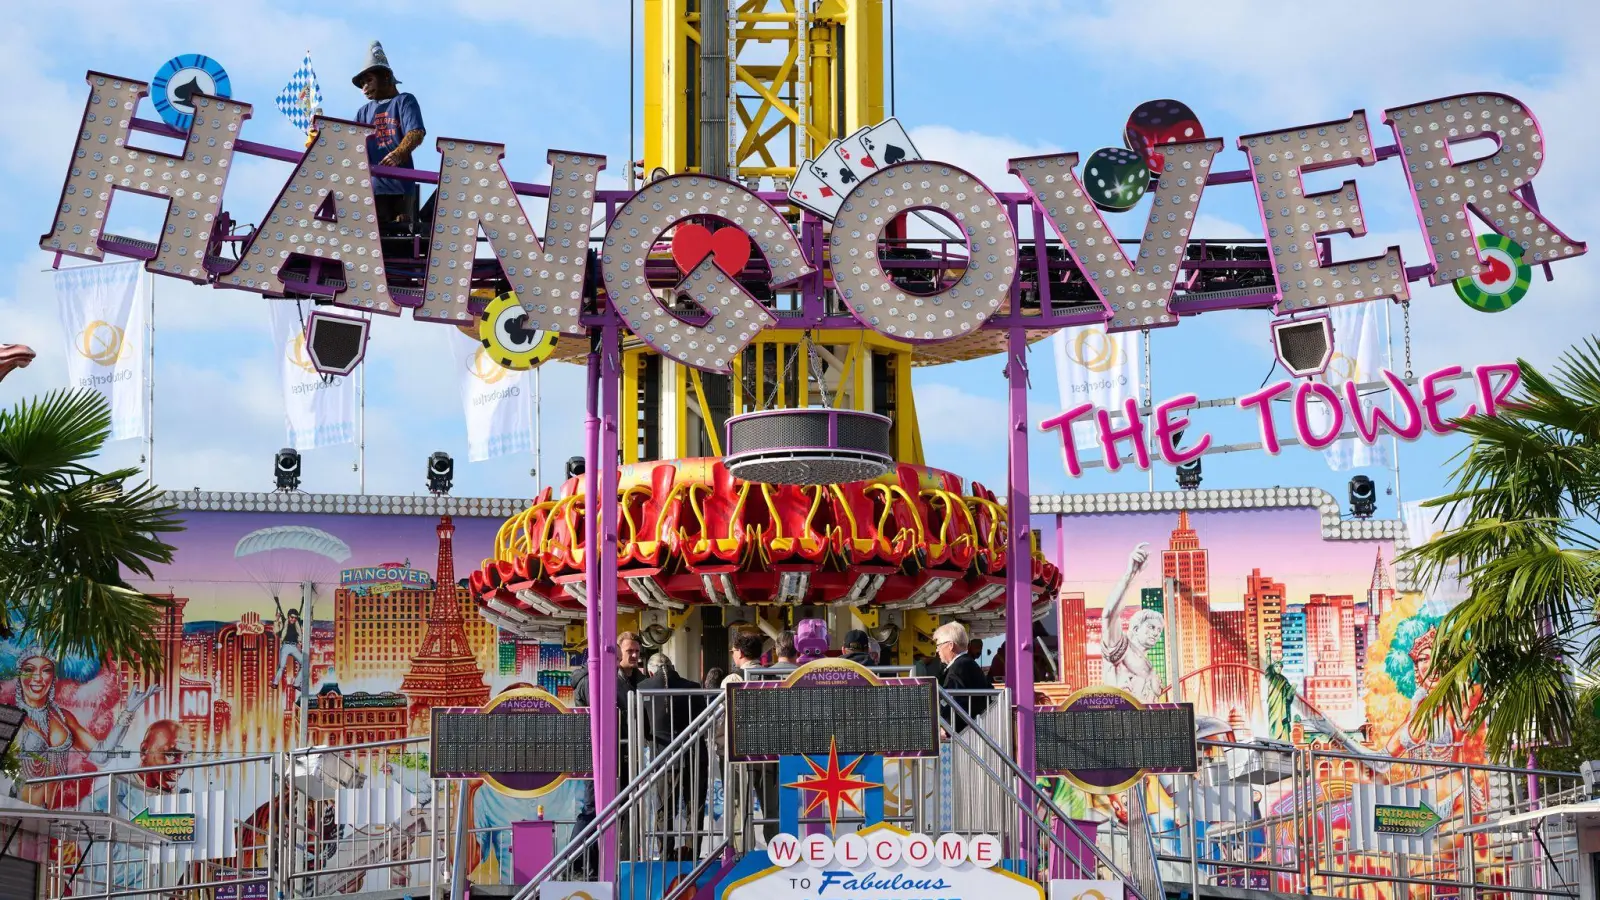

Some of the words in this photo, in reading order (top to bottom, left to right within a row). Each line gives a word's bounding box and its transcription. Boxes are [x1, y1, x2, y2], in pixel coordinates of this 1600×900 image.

[40, 70, 1587, 372] HANGOVER
[1040, 394, 1212, 477] THE
[1238, 362, 1532, 456] TOWER
[342, 569, 431, 584] HANGOVER
[803, 672, 860, 680] HANGOVER
[500, 700, 551, 708] HANGOVER
[1076, 697, 1126, 705] HANGOVER
[1375, 808, 1433, 820] ENTRANCE
[135, 817, 195, 827] ENTRANCE
[1382, 817, 1426, 828] EINGANG
[148, 826, 194, 835] INGANG
[773, 841, 992, 861] WELCOME
[790, 878, 811, 889] TO
[817, 871, 951, 896] Fabulous
